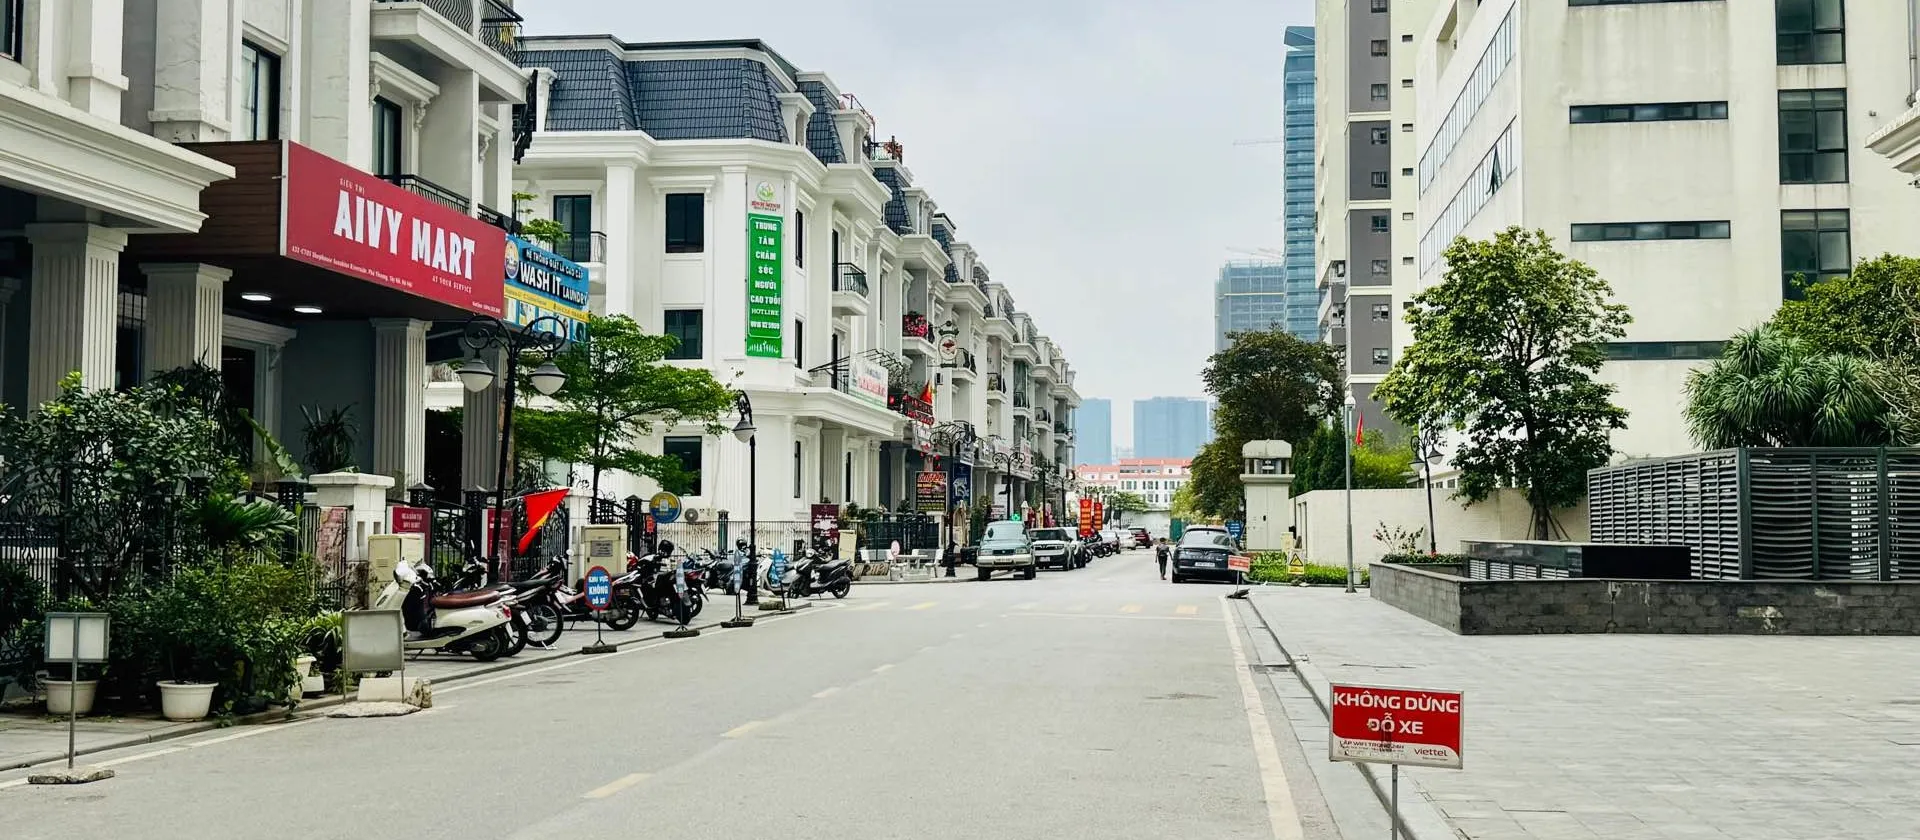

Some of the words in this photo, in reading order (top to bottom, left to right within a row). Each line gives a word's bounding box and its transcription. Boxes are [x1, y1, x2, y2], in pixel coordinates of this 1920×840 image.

[755, 221, 777, 231] TRUNG
[334, 189, 403, 256] AIVY
[411, 217, 475, 280] MART
[758, 235, 775, 246] TÂM
[755, 250, 776, 260] CHĂM
[758, 264, 774, 275] SÓC
[520, 261, 550, 292] WASH
[552, 273, 562, 296] IT
[562, 285, 588, 305] LAUNDRY
[755, 278, 777, 290] NGƯỜI
[750, 295, 764, 304] CAO
[765, 292, 781, 305] TUỔI
[751, 308, 779, 316] HOTLINE
[588, 583, 608, 595] KHÔNG
[1333, 690, 1401, 709] KHÔNG
[1405, 693, 1459, 713] DỪNG
[1366, 712, 1395, 732] ĐỖ
[1399, 720, 1424, 735] XE
[1414, 747, 1448, 757] viettel
